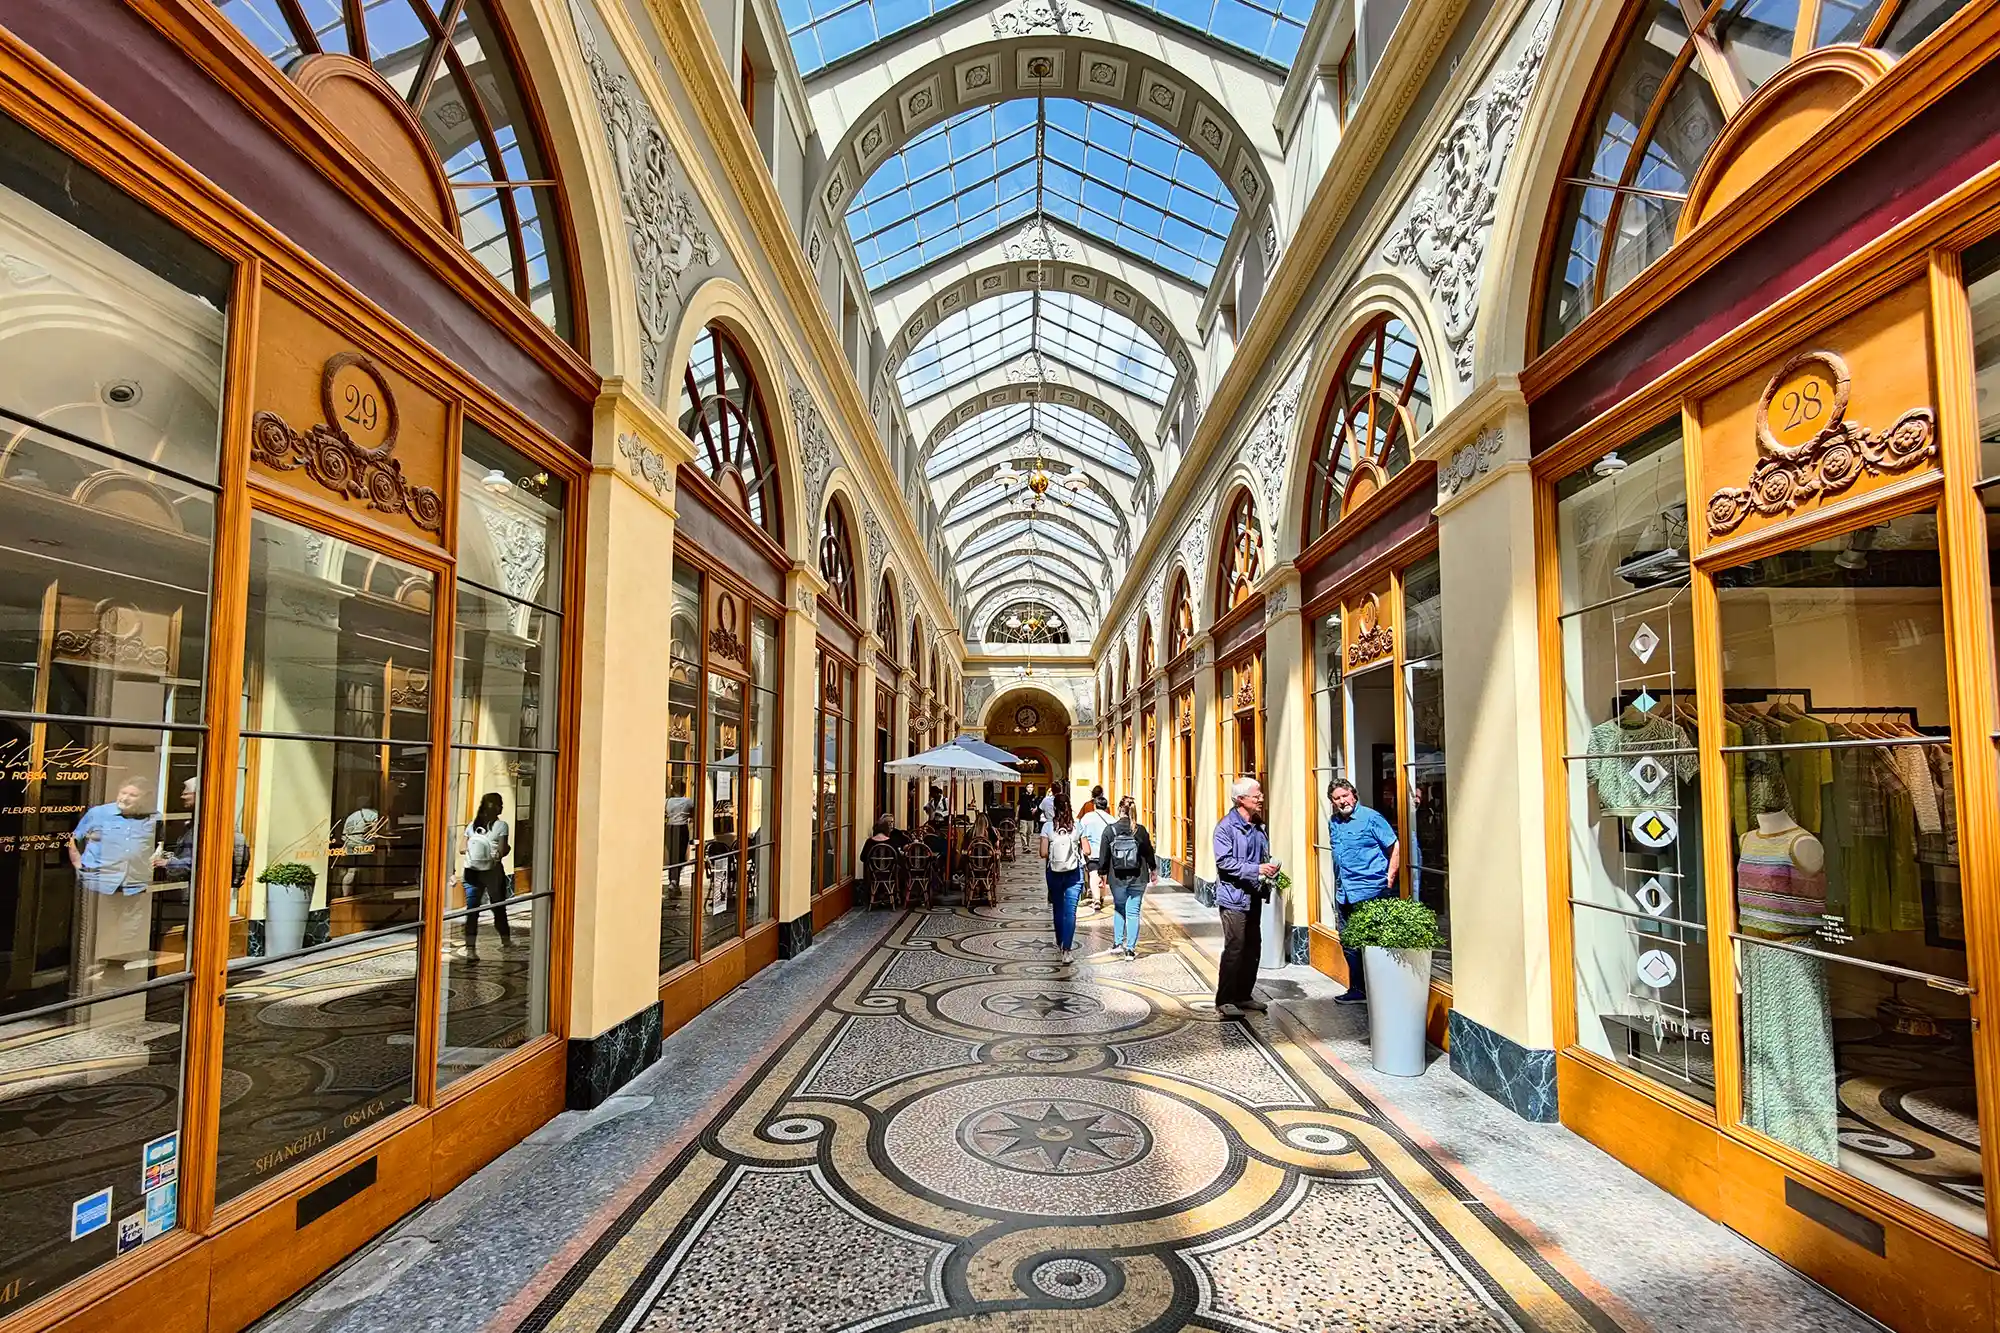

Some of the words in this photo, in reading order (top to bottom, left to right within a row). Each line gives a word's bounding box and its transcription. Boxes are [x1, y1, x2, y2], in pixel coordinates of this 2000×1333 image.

[344, 384, 377, 430] 29
[1782, 381, 1822, 432] 28
[12, 771, 47, 780] ROBBA
[56, 771, 89, 780] STUDIO
[2, 806, 37, 814] FLEURS
[19, 834, 52, 842] VIVIENNE
[4, 844, 15, 852] 01
[34, 842, 45, 850] 60
[352, 844, 376, 854] STUDIO
[1660, 1014, 1710, 1045] André
[255, 1126, 327, 1175] SHANGHAI
[343, 1100, 385, 1129] OSAKA
[122, 1220, 140, 1234] tax
[123, 1227, 143, 1244] free
